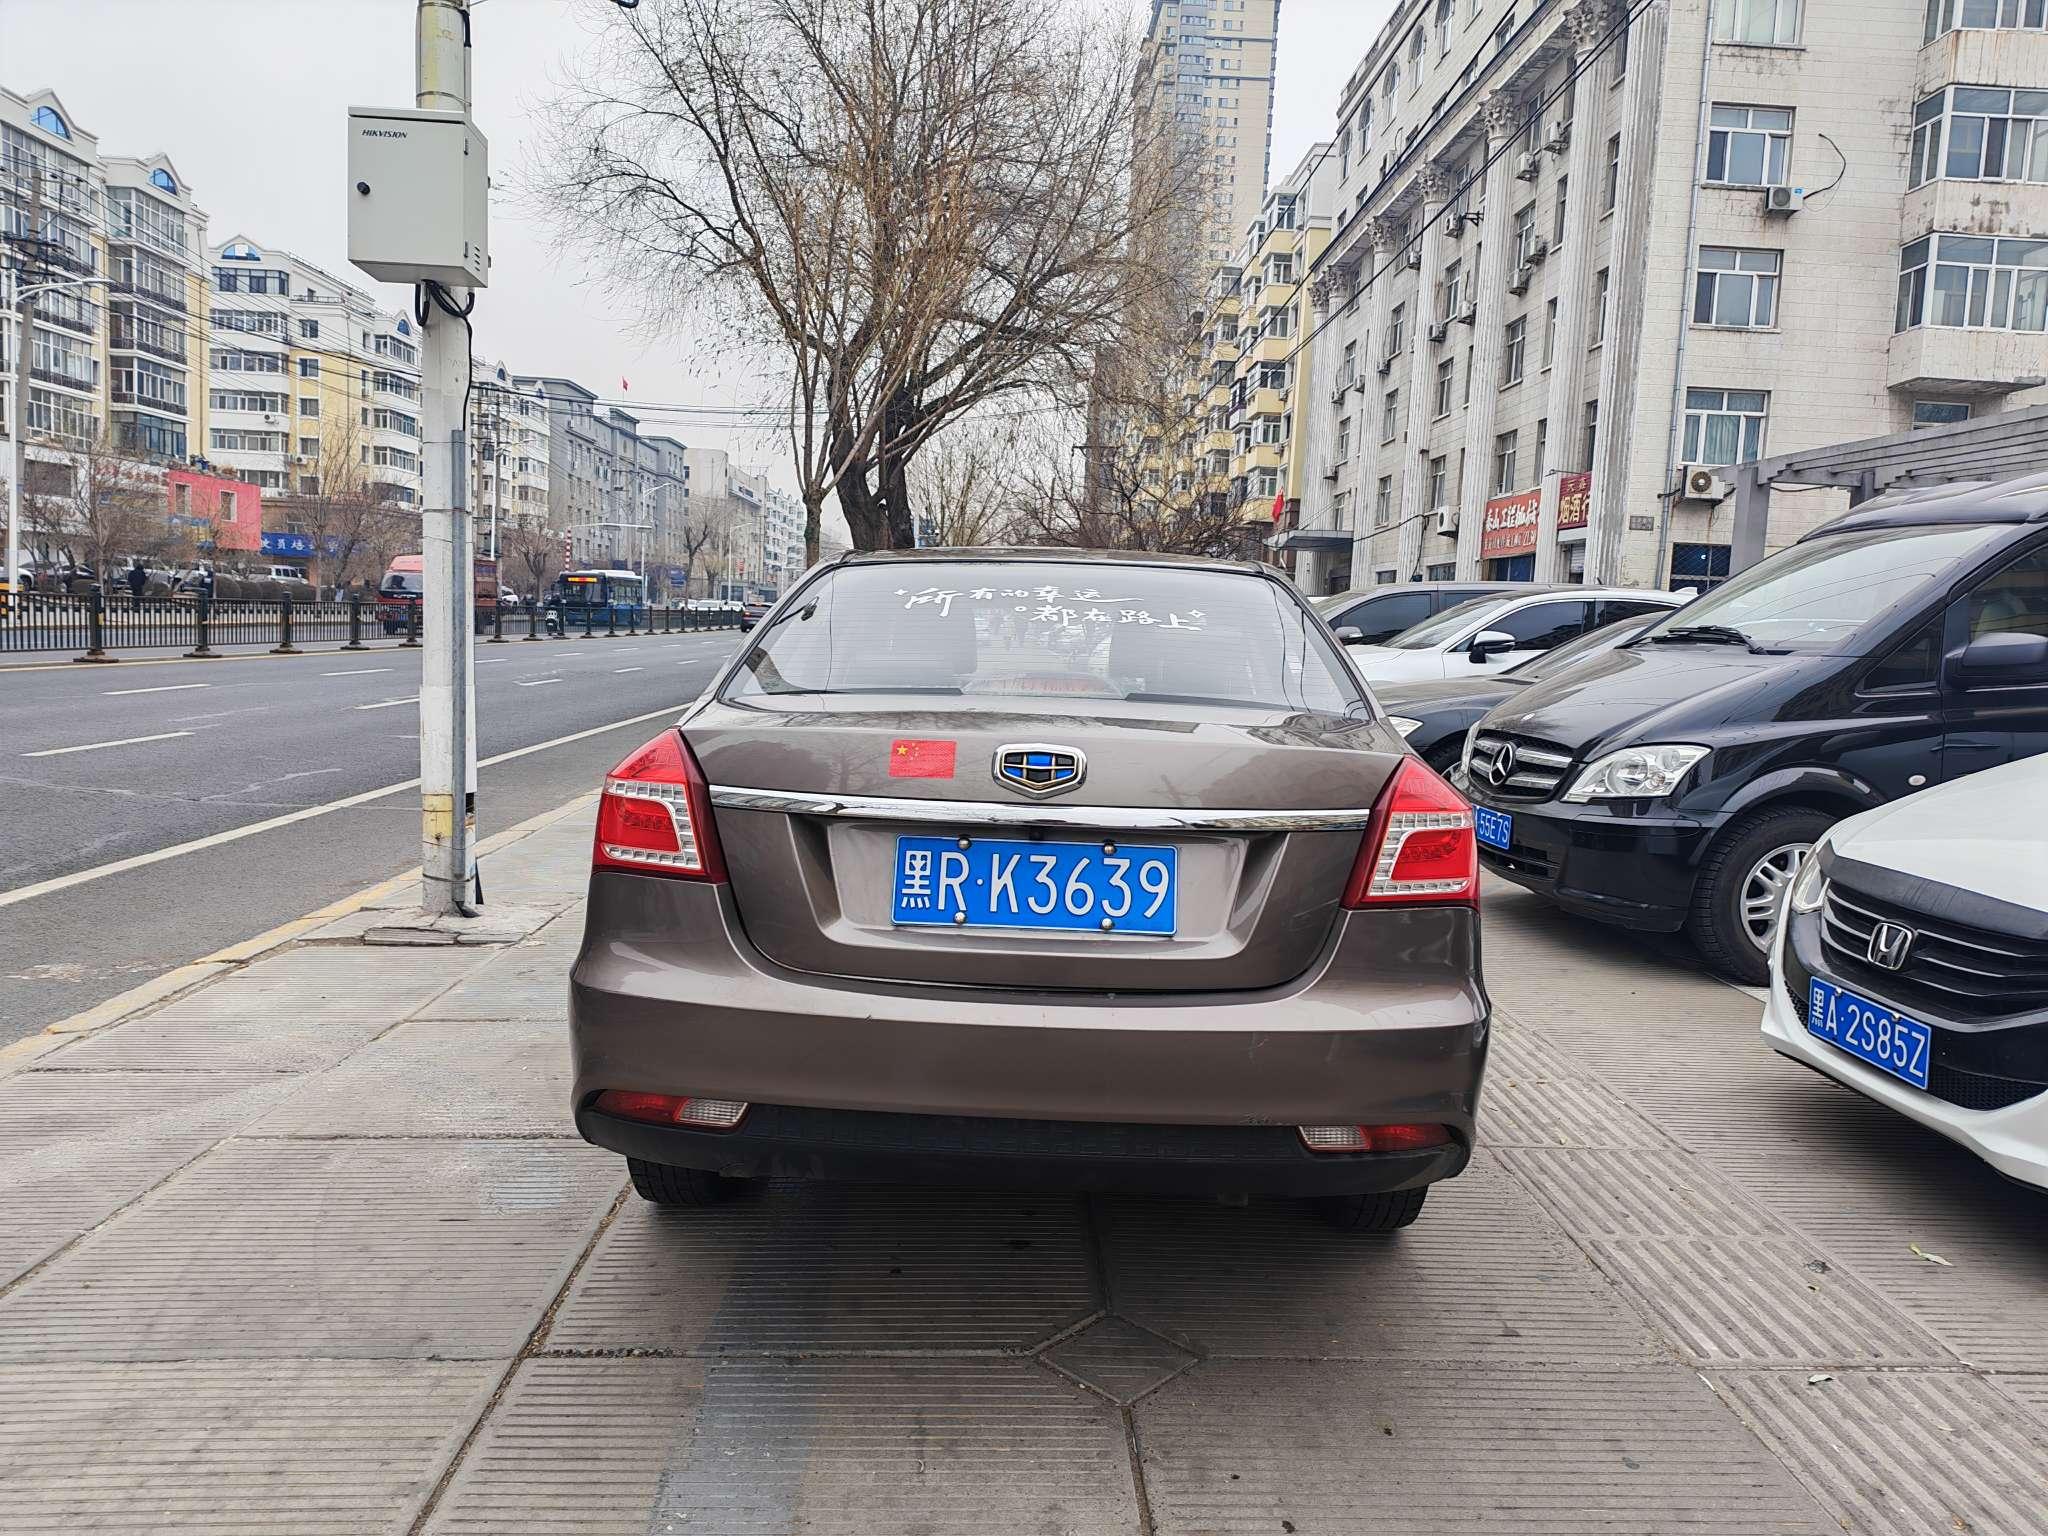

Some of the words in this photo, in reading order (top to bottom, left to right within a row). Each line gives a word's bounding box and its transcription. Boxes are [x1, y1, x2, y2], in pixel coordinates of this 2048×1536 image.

[361, 129, 407, 139] HIKVISION
[904, 587, 1144, 617] 所有的幸运
[1030, 605, 1202, 632] 都在路上
[901, 850, 1169, 918] 黑R·K3639
